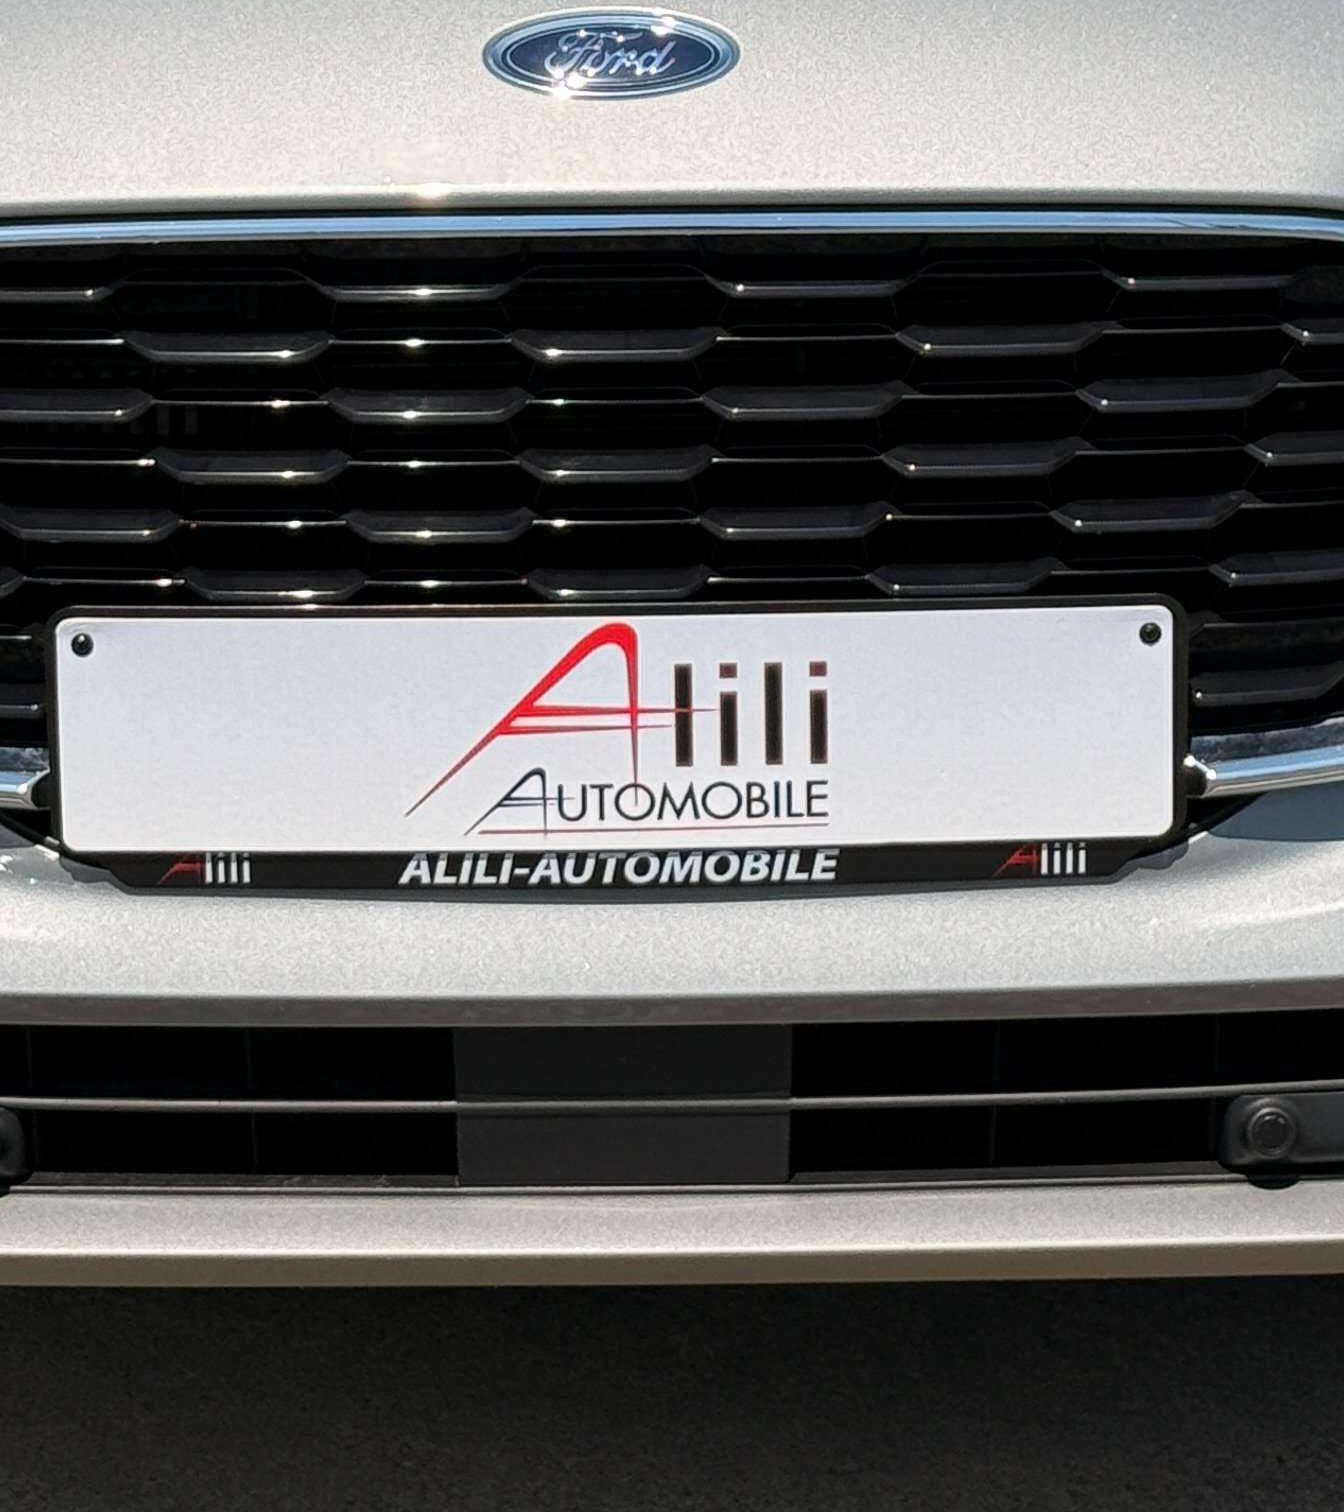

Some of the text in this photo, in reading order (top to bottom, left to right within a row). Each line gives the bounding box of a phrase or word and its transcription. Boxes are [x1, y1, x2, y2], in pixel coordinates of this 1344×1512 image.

[544, 31, 676, 76] Ford
[405, 621, 829, 817] Alili
[463, 767, 830, 836] AUTOMOBILE
[399, 849, 840, 885] ALILI-AUTOMOBILE
